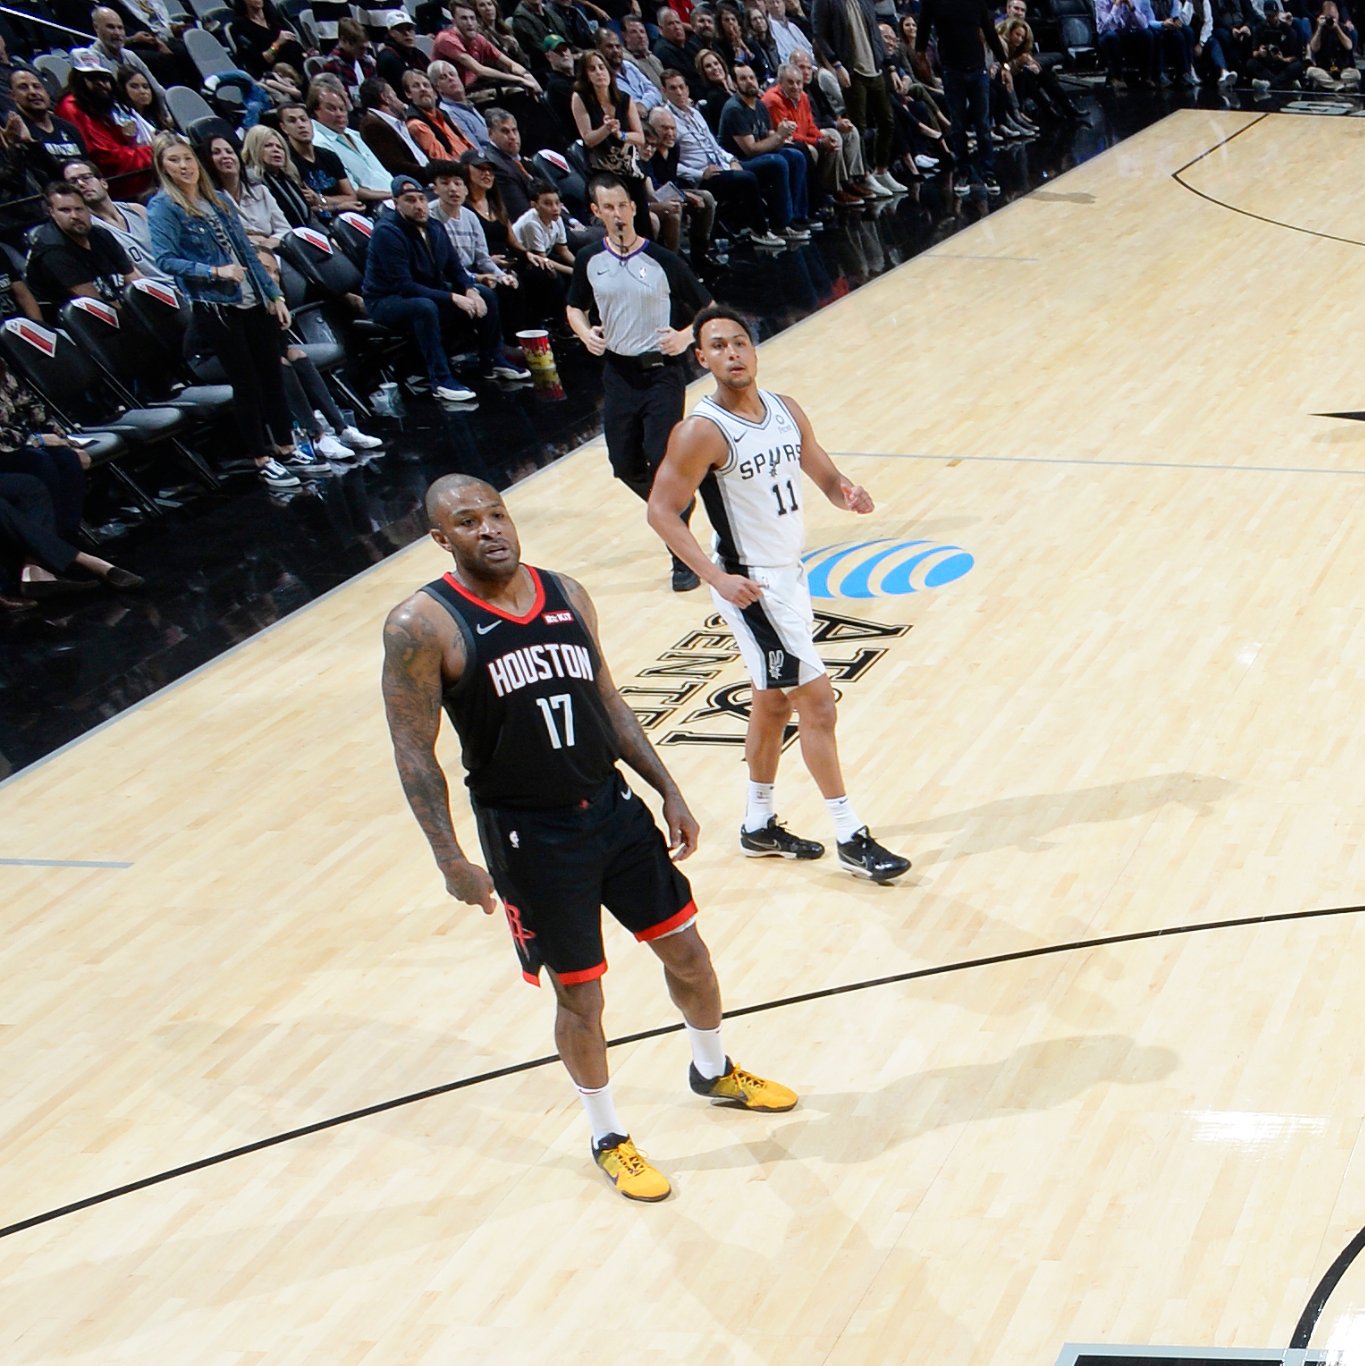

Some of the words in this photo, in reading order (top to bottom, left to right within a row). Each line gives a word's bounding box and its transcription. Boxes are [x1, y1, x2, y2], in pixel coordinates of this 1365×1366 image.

[771, 480, 799, 516] 11
[488, 643, 594, 697] HOUSTON
[536, 693, 575, 749] 17
